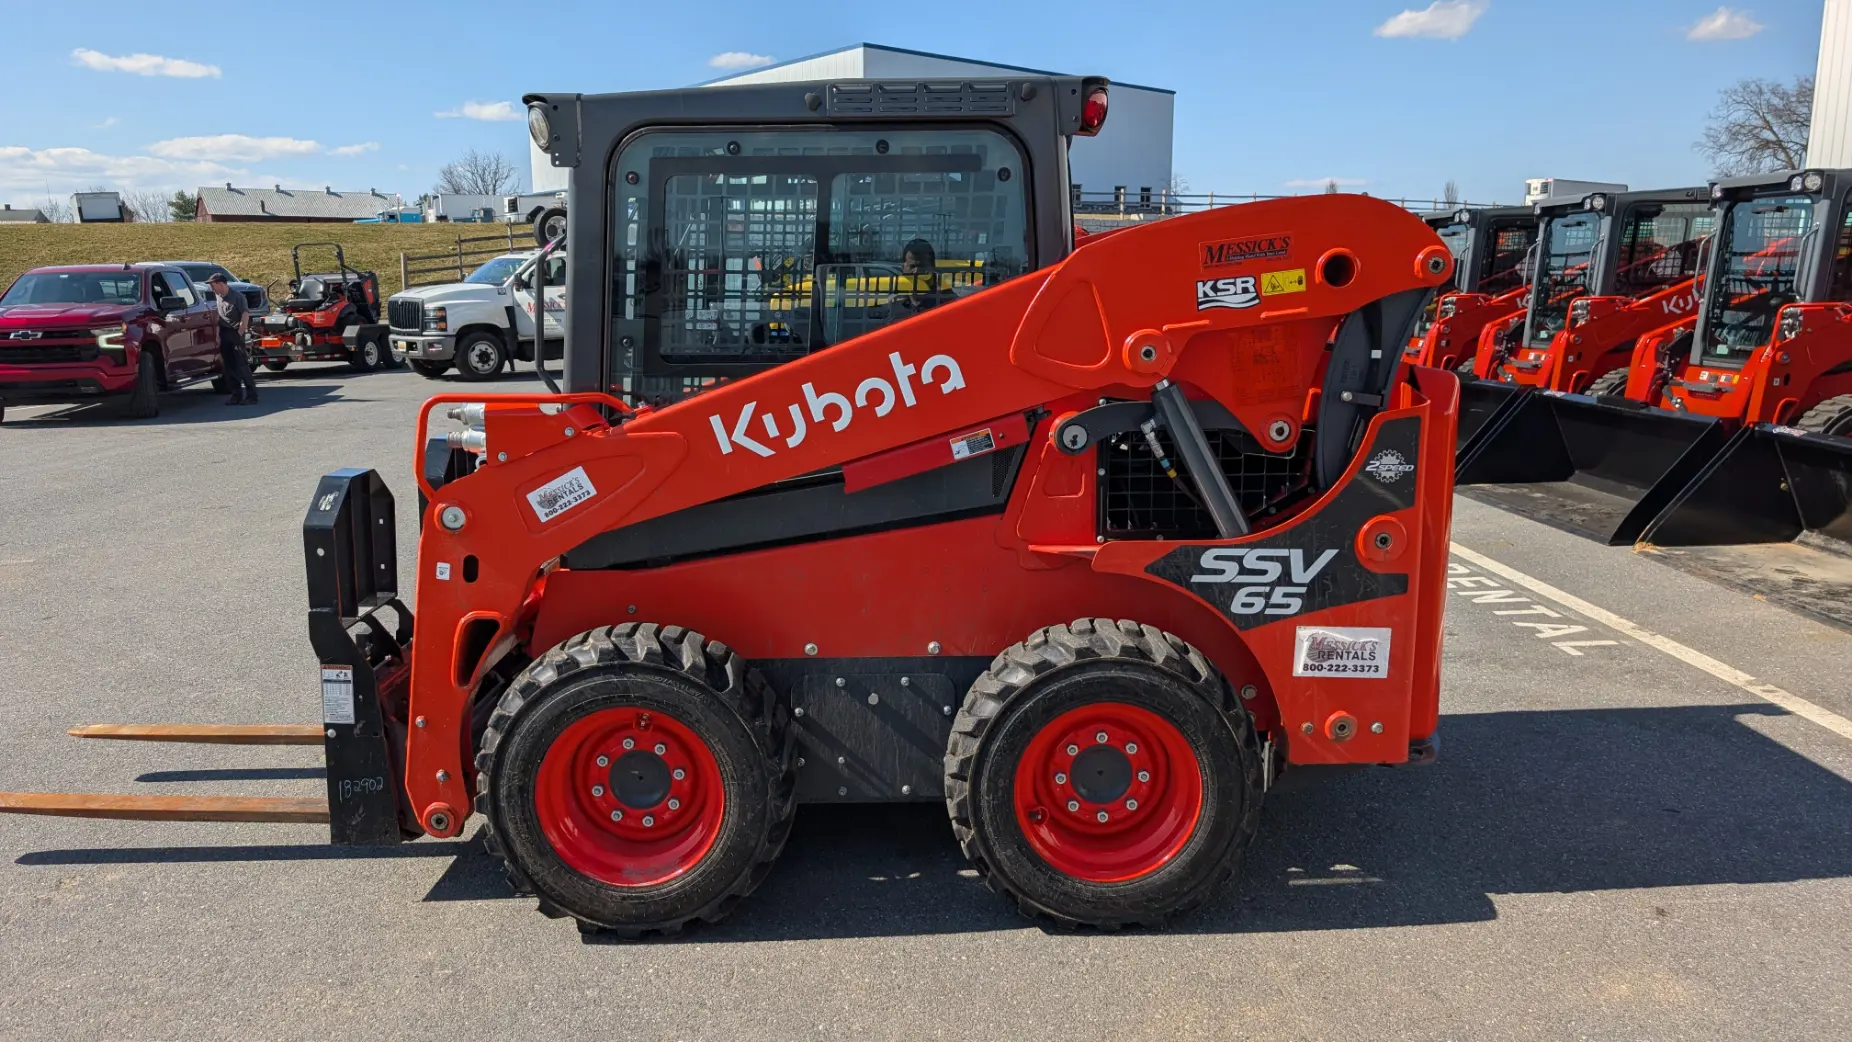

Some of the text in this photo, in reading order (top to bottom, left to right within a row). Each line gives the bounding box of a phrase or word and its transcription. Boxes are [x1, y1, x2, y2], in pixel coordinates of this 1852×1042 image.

[1203, 236, 1291, 266] MESSICK'S
[1197, 276, 1256, 298] KSR
[709, 351, 966, 458] Kubota
[544, 489, 591, 518] 800-222-3373
[547, 483, 585, 507] RENTALS
[1190, 548, 1340, 584] SSV
[1230, 586, 1307, 615] 65
[1302, 663, 1380, 673] 800-222-3373
[1317, 651, 1377, 661] RENTALS
